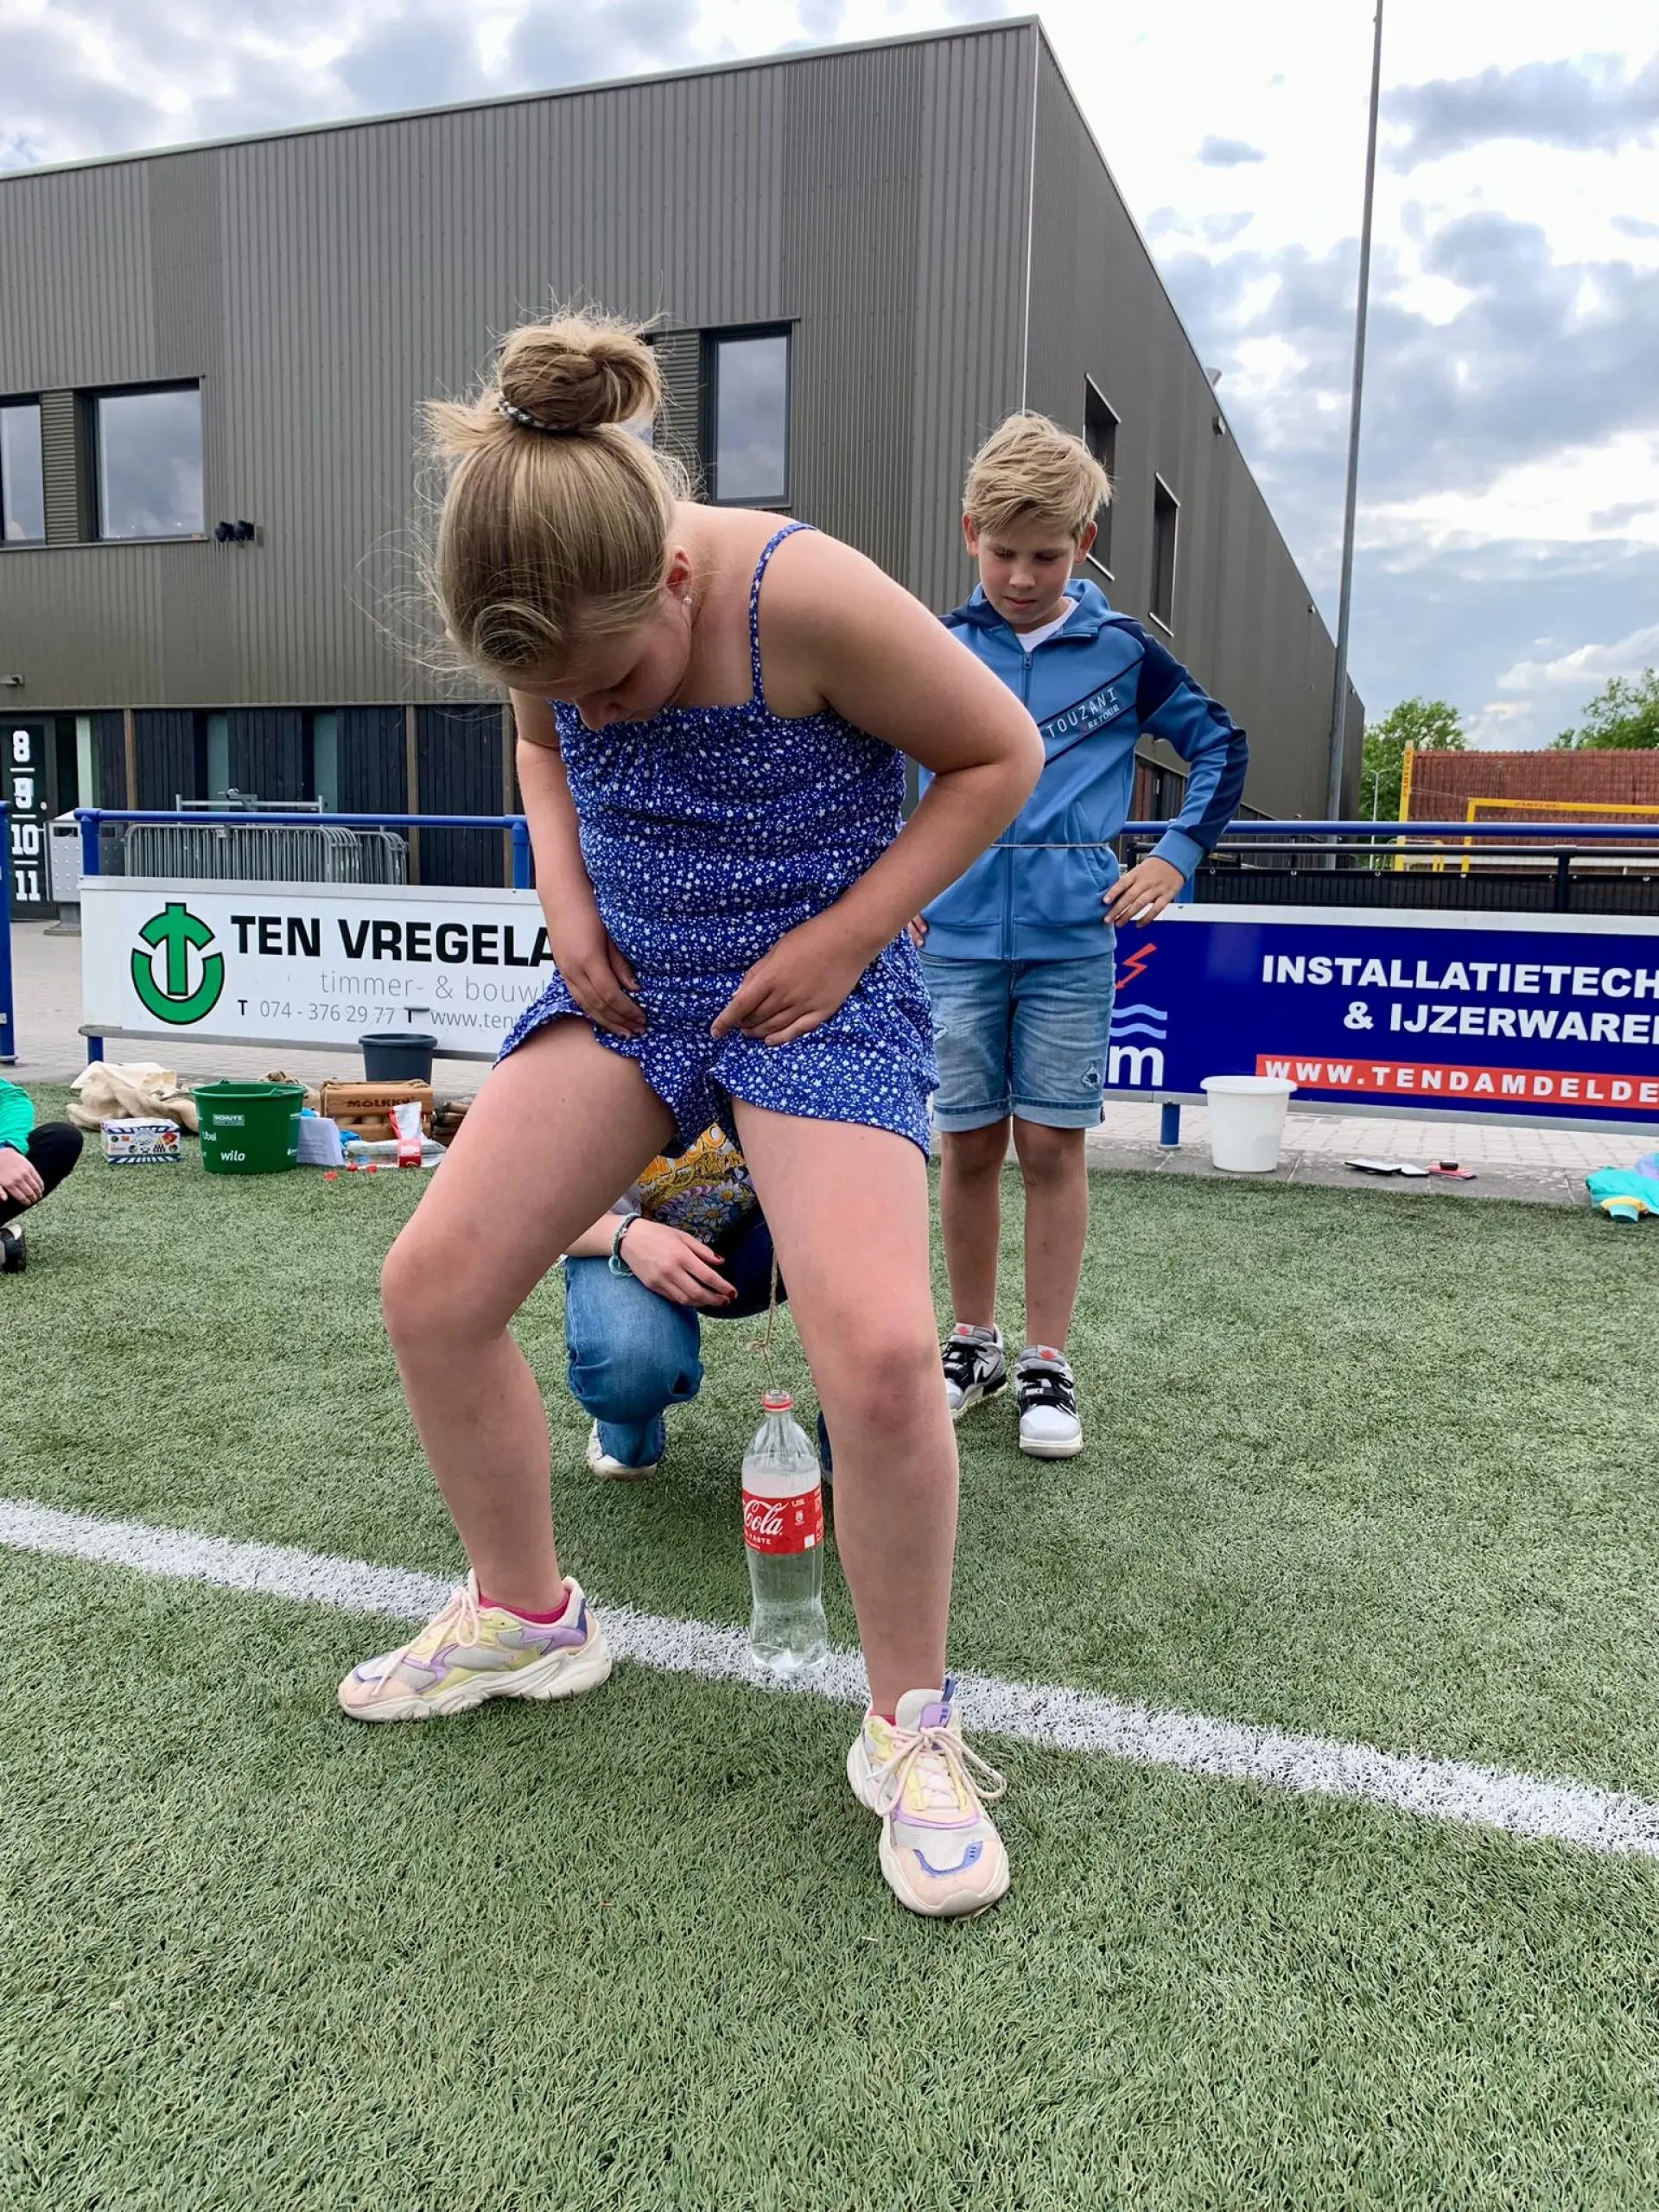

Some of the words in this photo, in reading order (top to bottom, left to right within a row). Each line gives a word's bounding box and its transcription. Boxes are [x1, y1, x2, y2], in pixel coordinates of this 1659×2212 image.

[1046, 687, 1117, 739] TOUZANI
[1087, 704, 1120, 729] RETOUR
[12, 730, 31, 762] 8
[13, 778, 34, 809] 9
[10, 824, 40, 855] 10
[15, 870, 41, 901] 11
[231, 915, 321, 957] TEN
[321, 969, 424, 998] timmer-
[435, 975, 454, 999] &
[1262, 955, 1659, 999] INSTALLATIETECH
[238, 999, 248, 1016] T
[259, 1001, 292, 1019] 074
[308, 1002, 341, 1022] 376
[346, 1005, 369, 1024] 29
[373, 1006, 396, 1026] 77
[430, 1008, 518, 1030] www.ten
[1343, 1001, 1375, 1030] &
[220, 1149, 246, 1162] wilo
[743, 1499, 790, 1535] Cola
